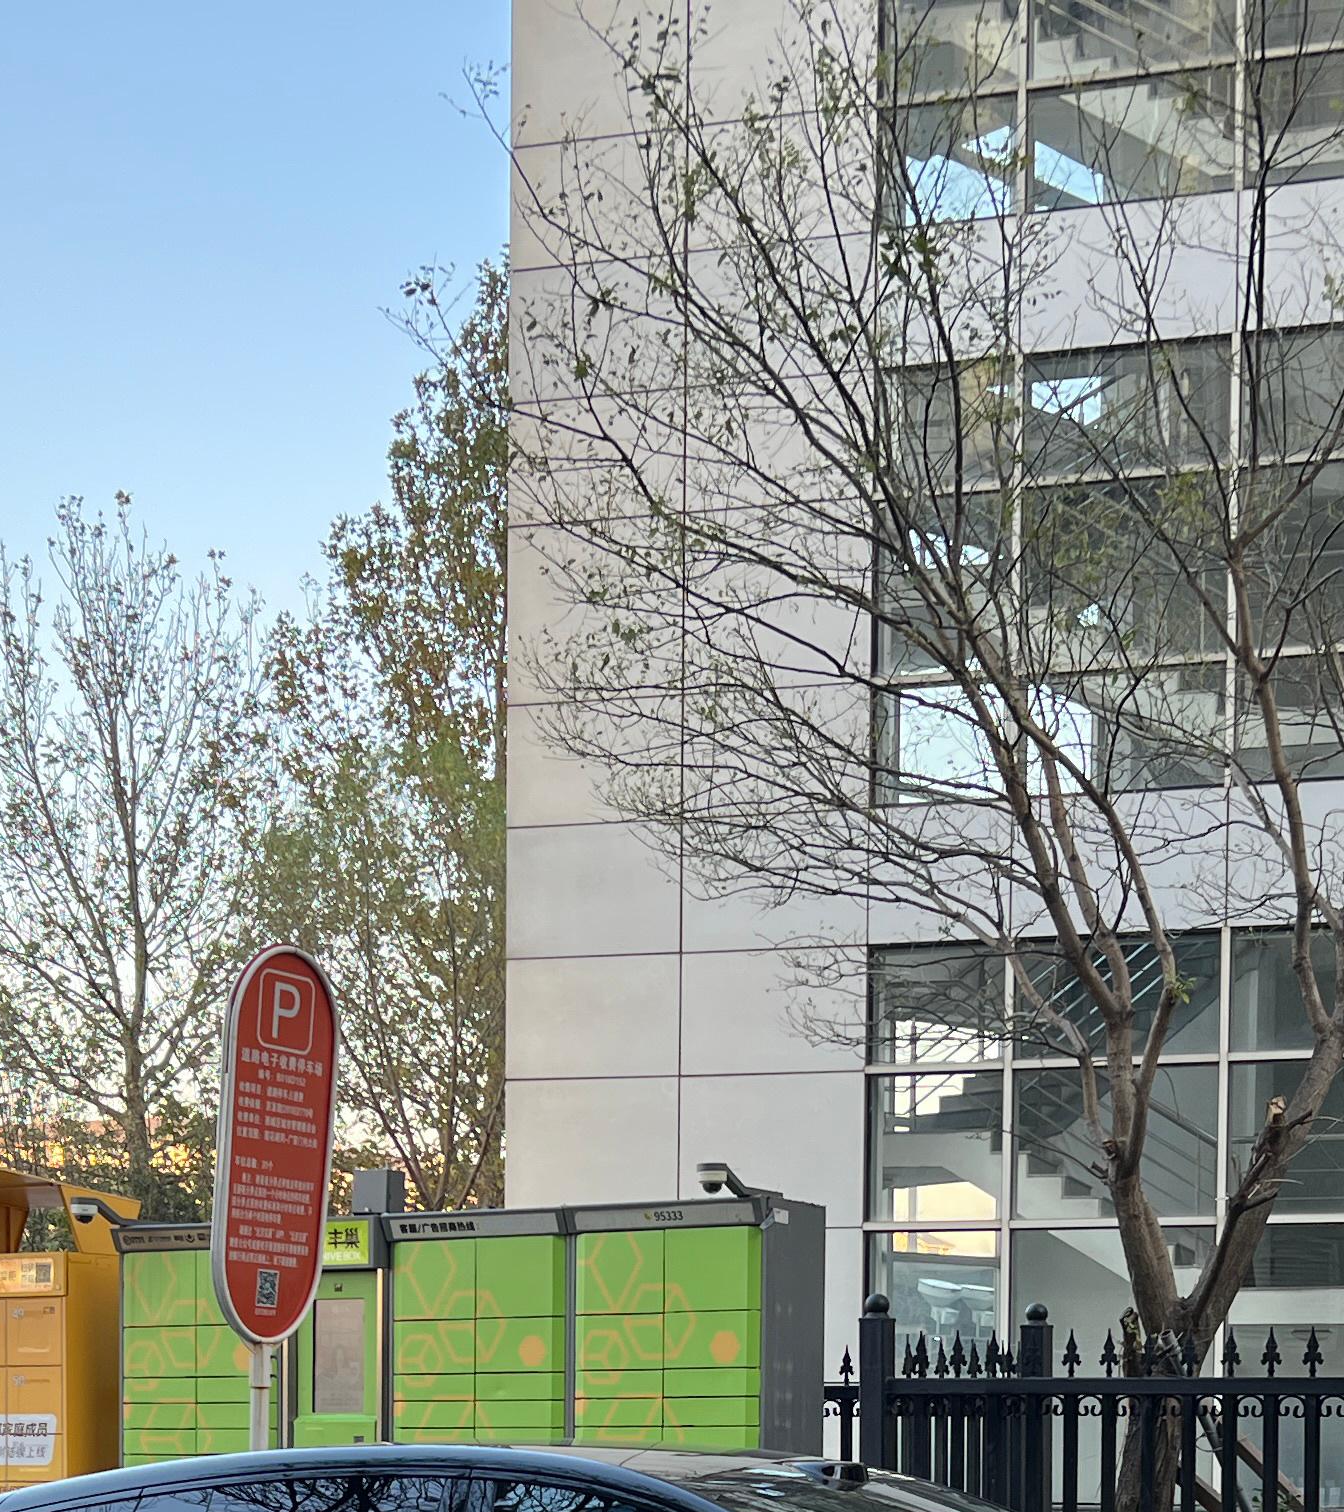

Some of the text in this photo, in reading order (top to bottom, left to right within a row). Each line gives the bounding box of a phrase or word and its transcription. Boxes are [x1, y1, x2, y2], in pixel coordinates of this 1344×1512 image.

[271, 981, 301, 1039] P
[654, 1210, 684, 1222] 95333
[327, 1227, 360, 1249] 丰巢
